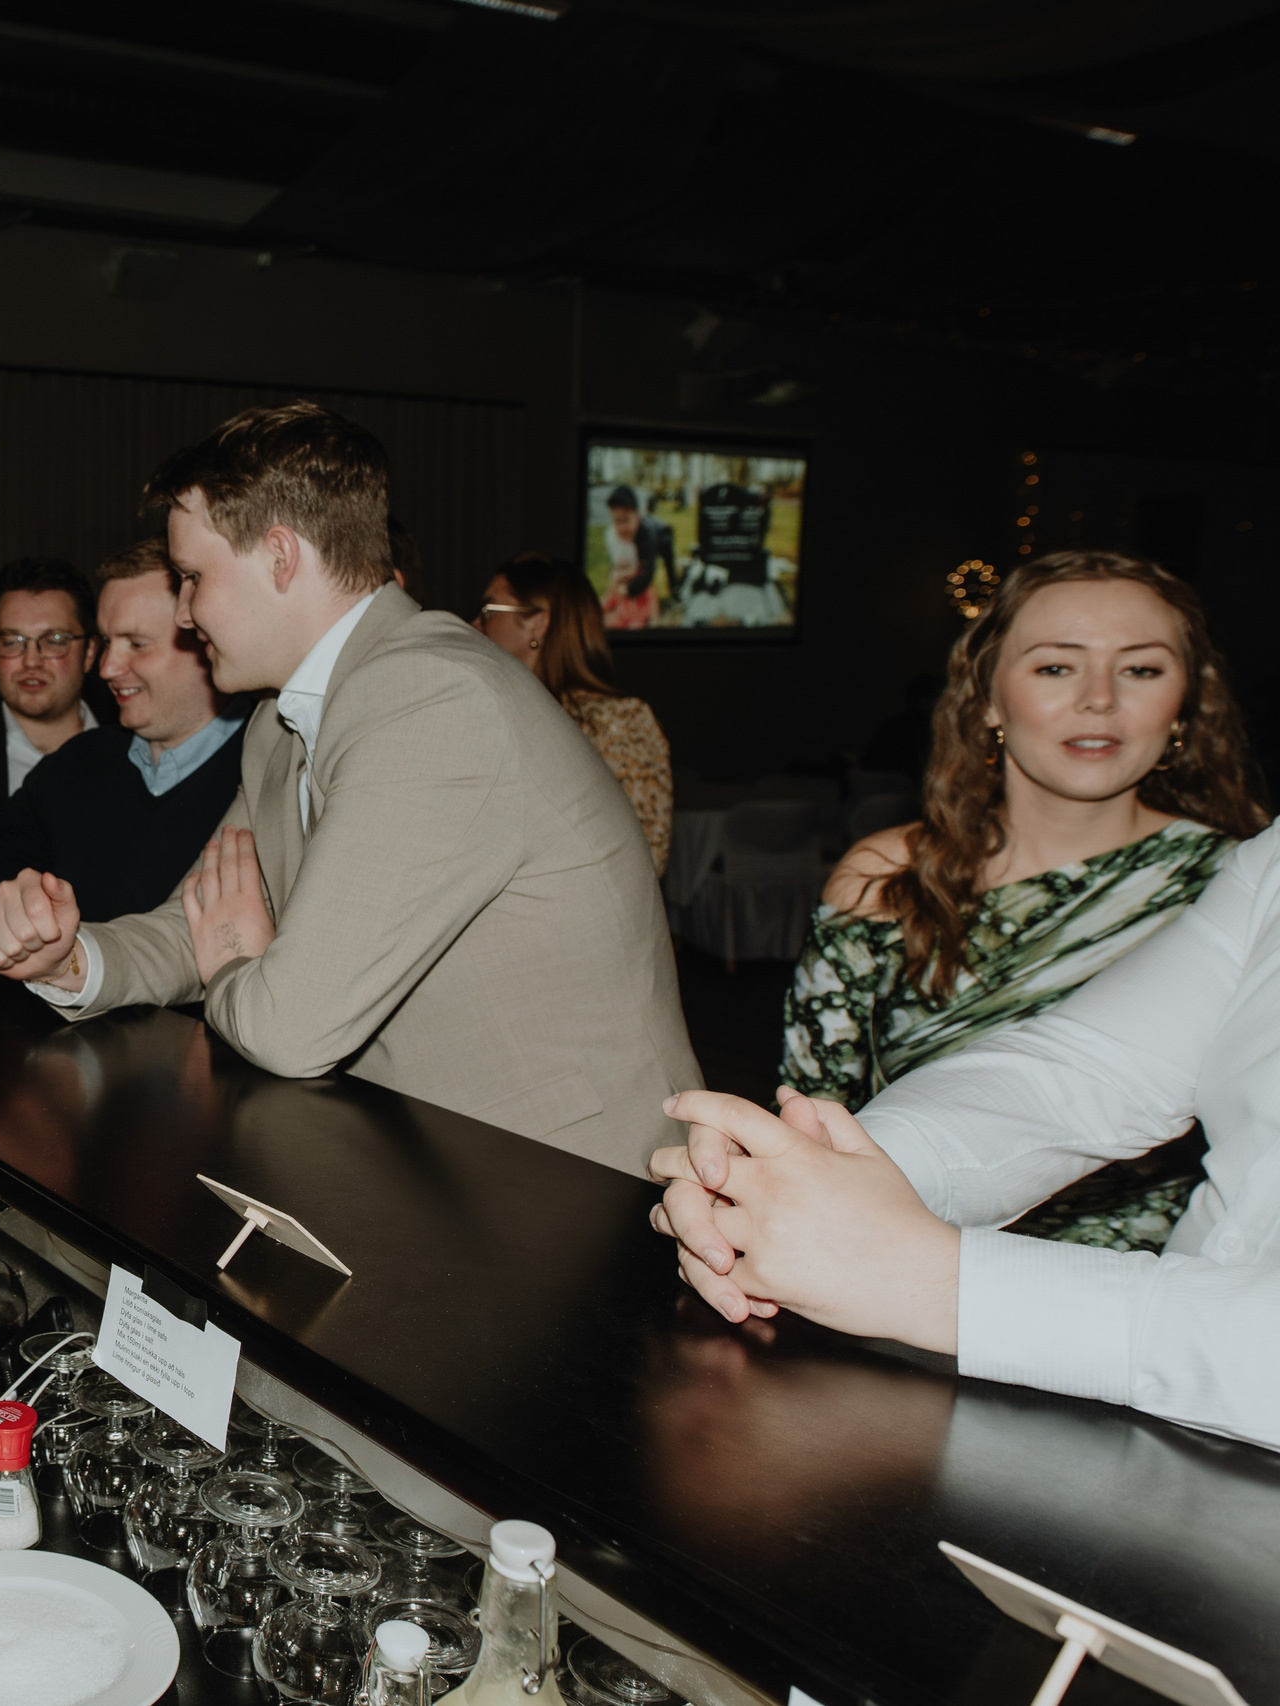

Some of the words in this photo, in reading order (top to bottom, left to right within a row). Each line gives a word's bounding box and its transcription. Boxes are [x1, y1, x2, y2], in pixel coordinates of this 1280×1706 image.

[132, 1315, 143, 1326] glas
[147, 1323, 156, 1335] lime
[117, 1329, 126, 1339] Mix
[131, 1326, 141, 1337] glas
[112, 1350, 124, 1362] Lime
